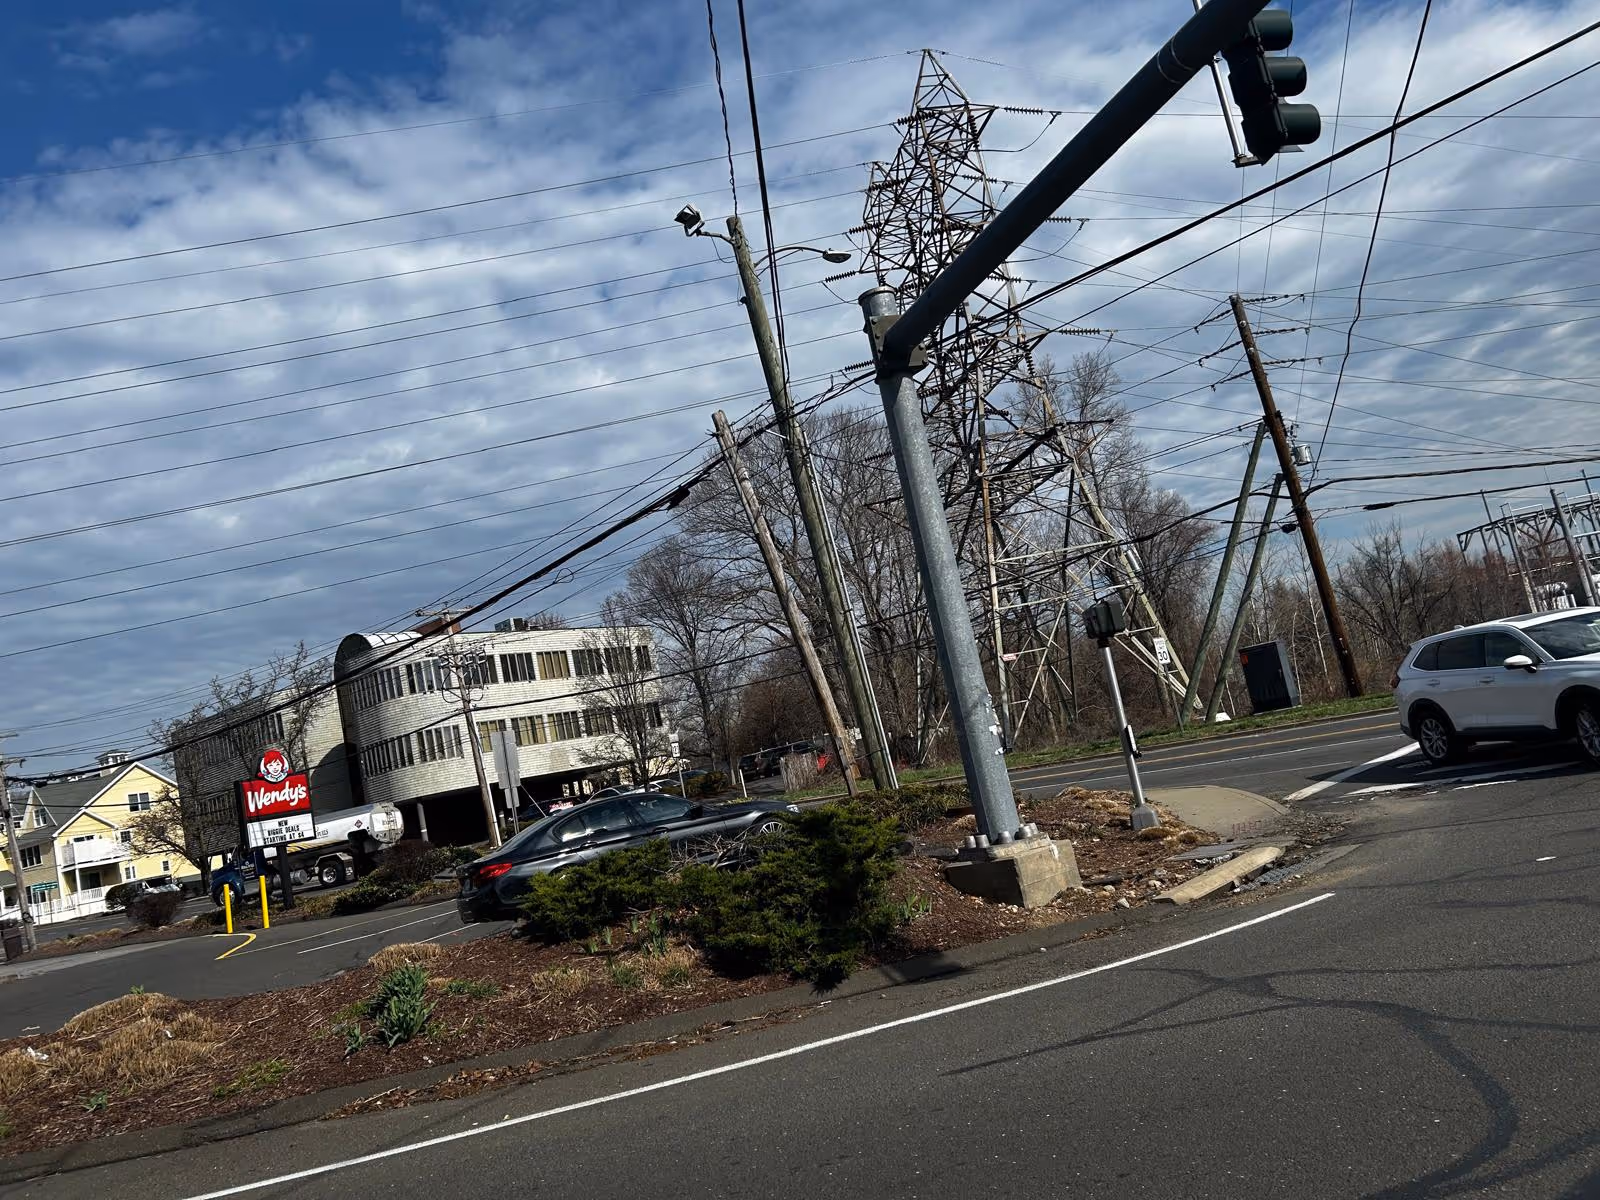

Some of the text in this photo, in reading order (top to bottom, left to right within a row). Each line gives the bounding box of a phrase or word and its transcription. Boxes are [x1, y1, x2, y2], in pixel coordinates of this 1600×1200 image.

[1158, 651, 1168, 661] 30
[246, 781, 307, 813] Wendy's
[285, 825, 299, 833] DEALS
[263, 835, 286, 845] STARTING
